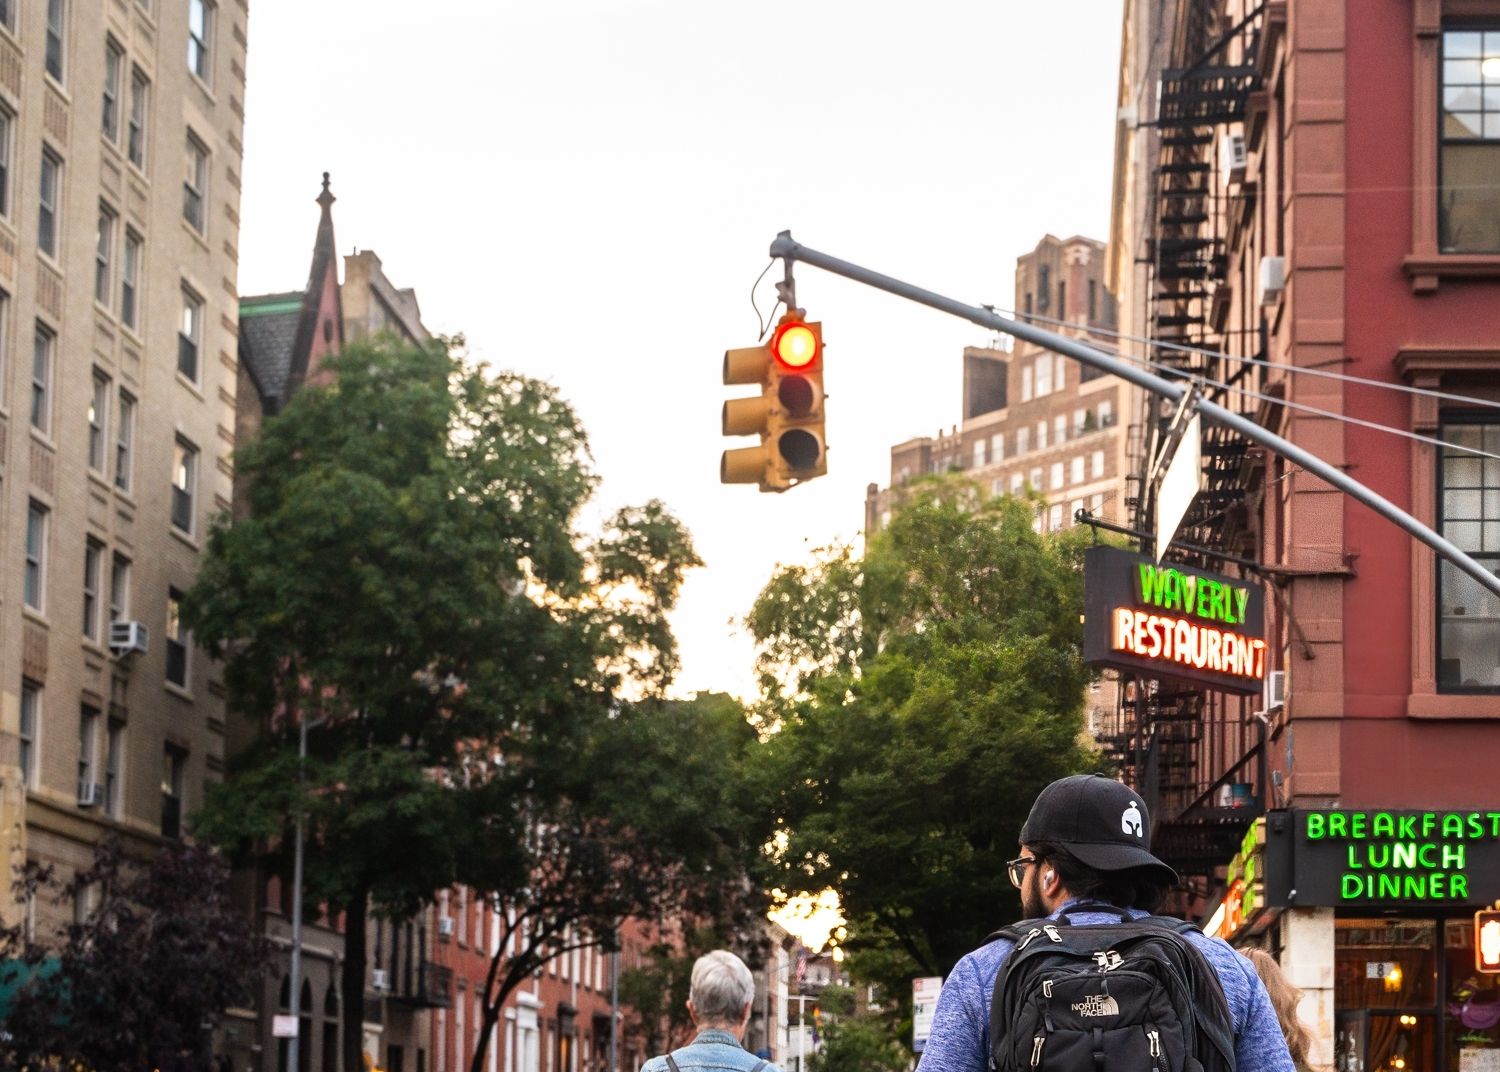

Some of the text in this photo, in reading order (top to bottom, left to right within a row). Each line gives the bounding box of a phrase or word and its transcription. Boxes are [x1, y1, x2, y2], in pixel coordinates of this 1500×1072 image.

[1138, 563, 1250, 624] WAVERLY
[1117, 608, 1267, 678] RESTAURANT
[1347, 842, 1467, 870] LUNCH
[1341, 874, 1470, 899] DINNER
[1072, 1003, 1103, 1011] NORTH
[1085, 995, 1102, 1003] THE
